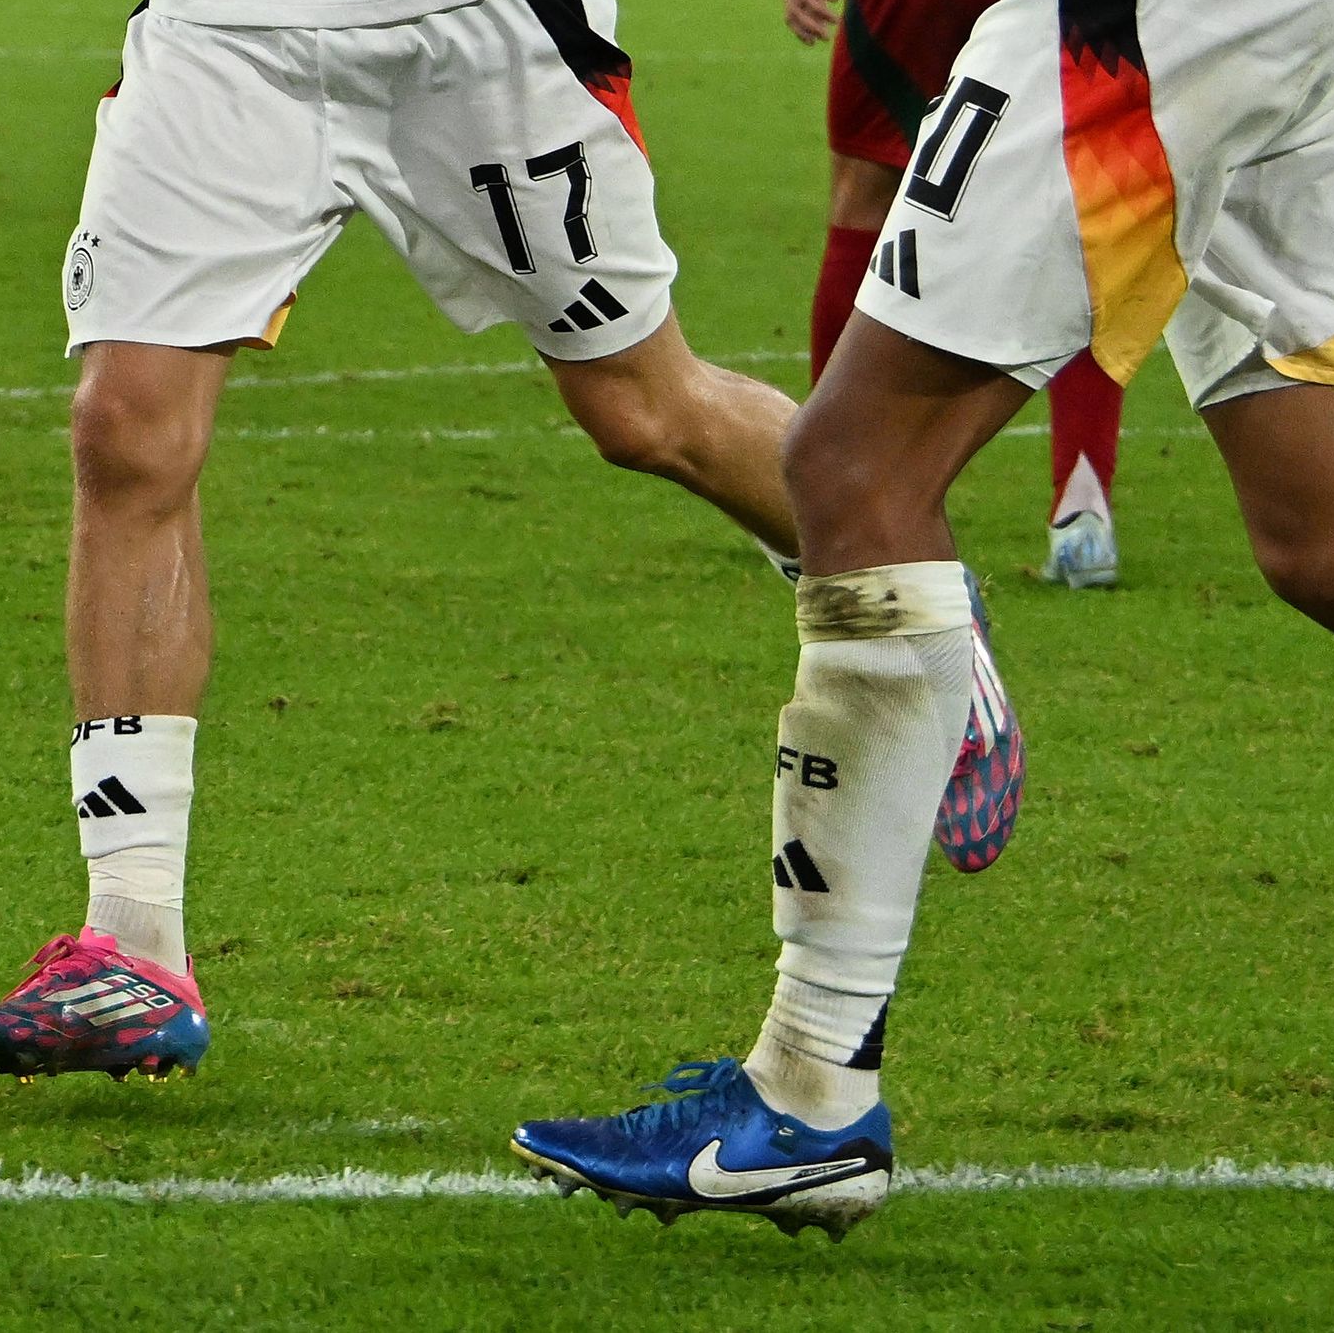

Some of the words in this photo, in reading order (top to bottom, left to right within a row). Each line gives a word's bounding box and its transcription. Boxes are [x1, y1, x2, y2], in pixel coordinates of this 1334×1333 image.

[469, 141, 598, 275] 17
[904, 74, 1011, 223] 0
[776, 745, 839, 790] FB
